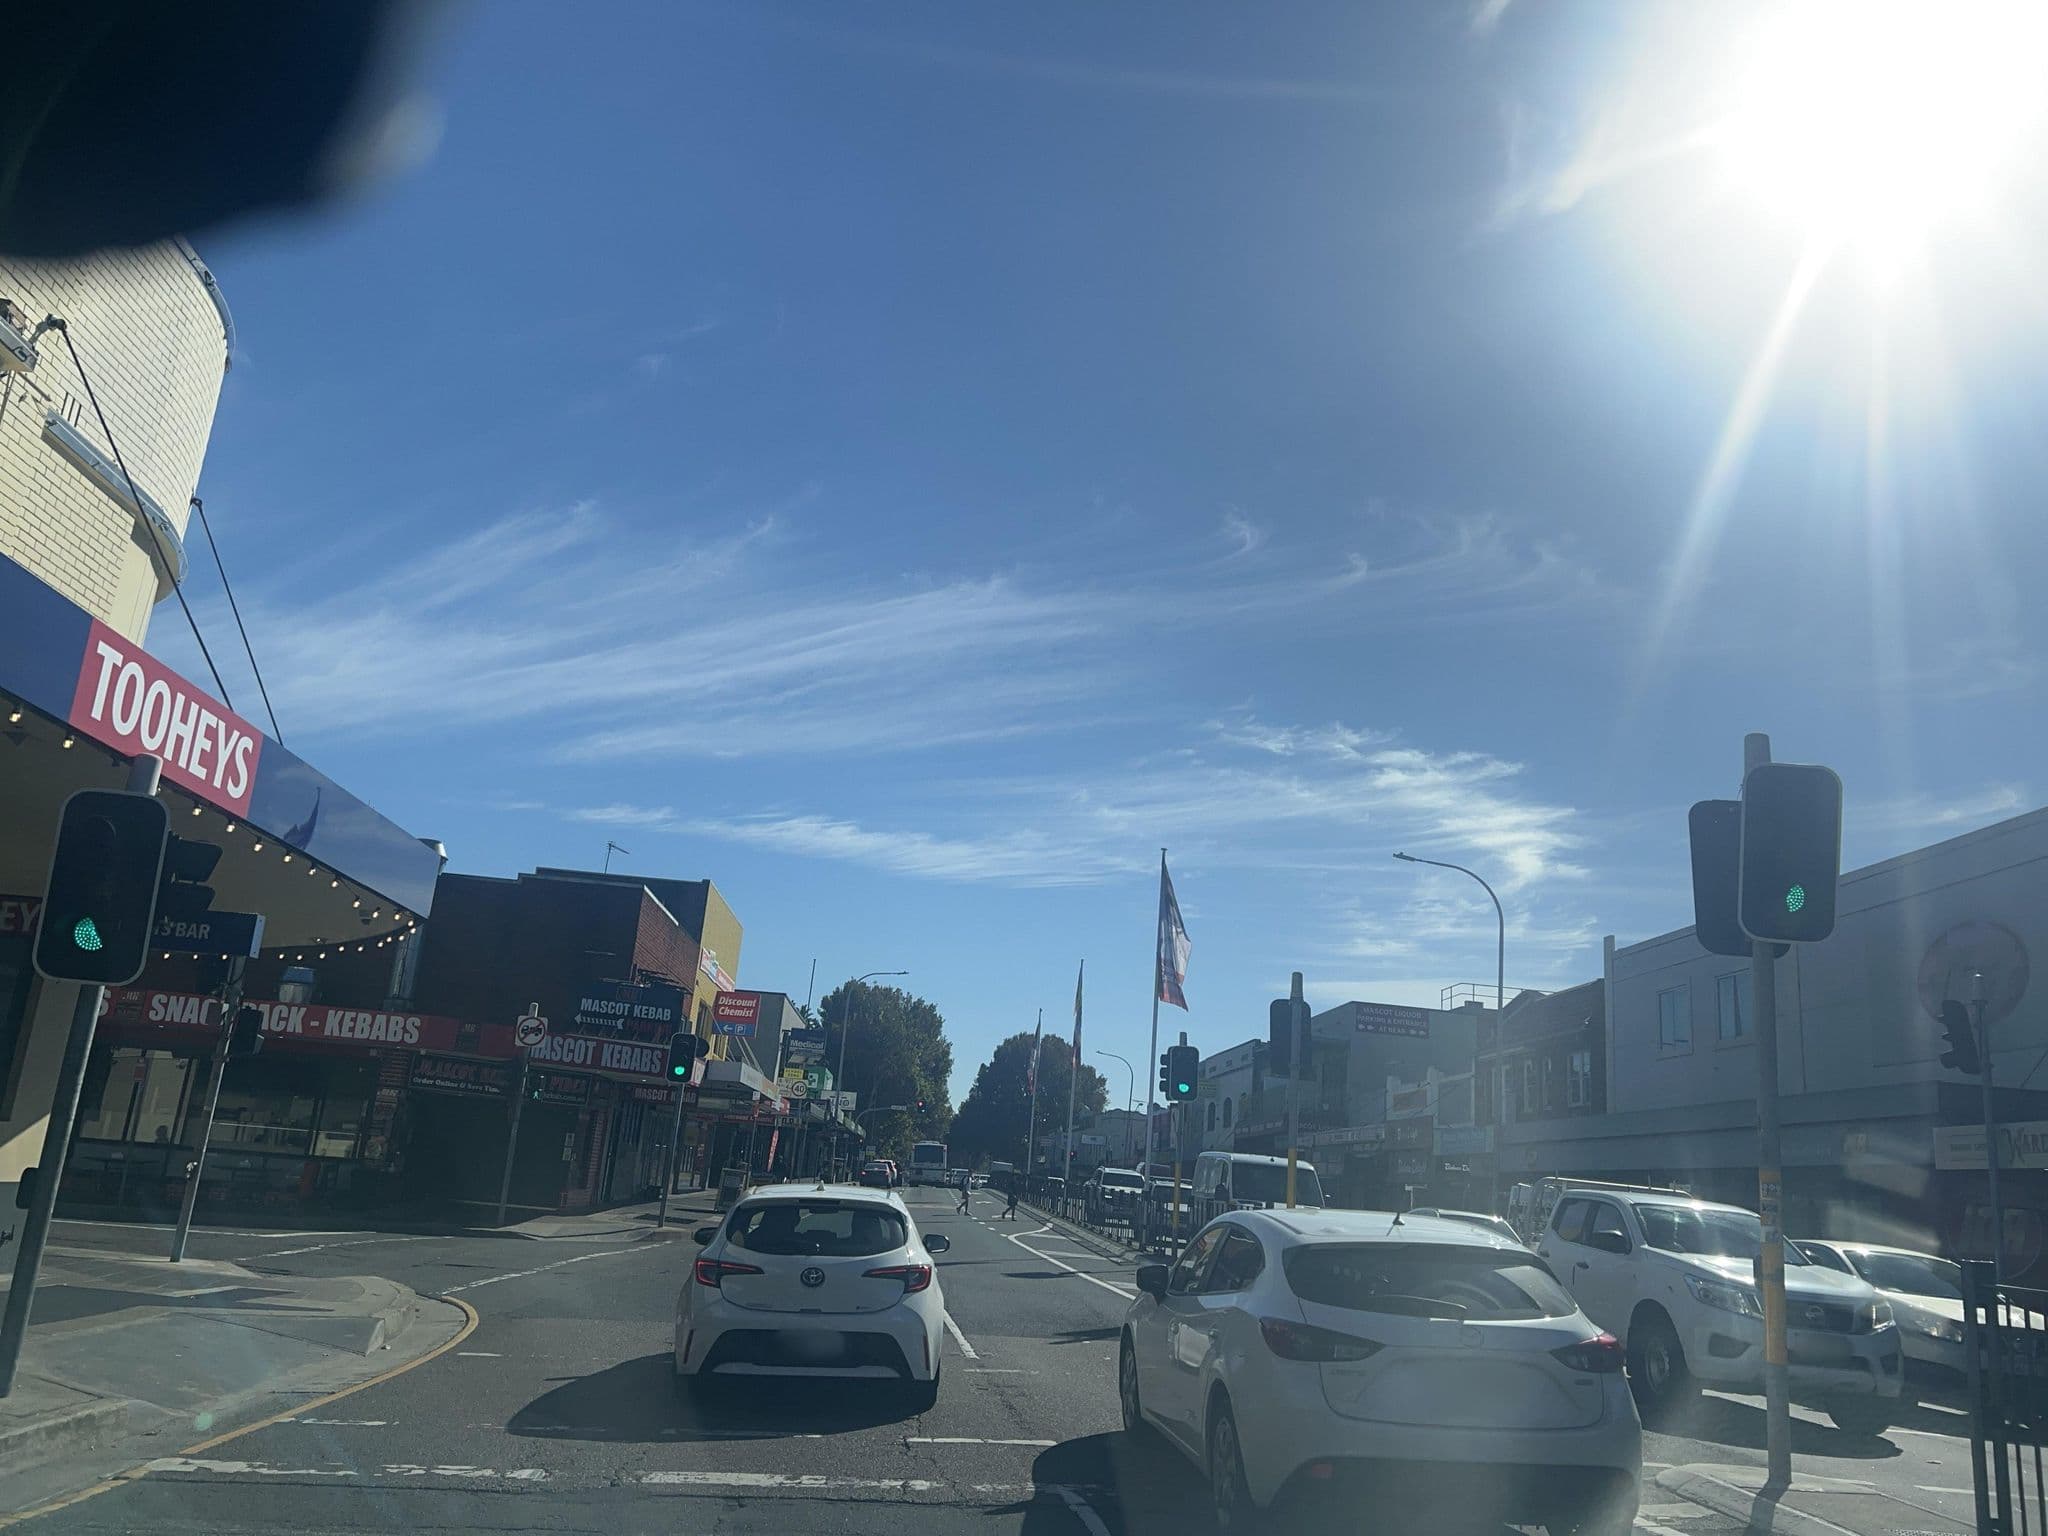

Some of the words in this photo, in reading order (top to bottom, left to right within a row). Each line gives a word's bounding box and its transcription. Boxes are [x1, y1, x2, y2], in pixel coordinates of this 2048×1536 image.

[90, 639, 254, 800] TOOHEYS
[175, 921, 211, 941] BAR
[580, 997, 631, 1017] MASCOT
[633, 1003, 672, 1022] KEBAB
[718, 995, 757, 1007] Discount
[718, 1006, 754, 1018] Chemist
[324, 1009, 422, 1045] KEBABS
[601, 1043, 663, 1074] KEBABS
[794, 1084, 805, 1093] 40
